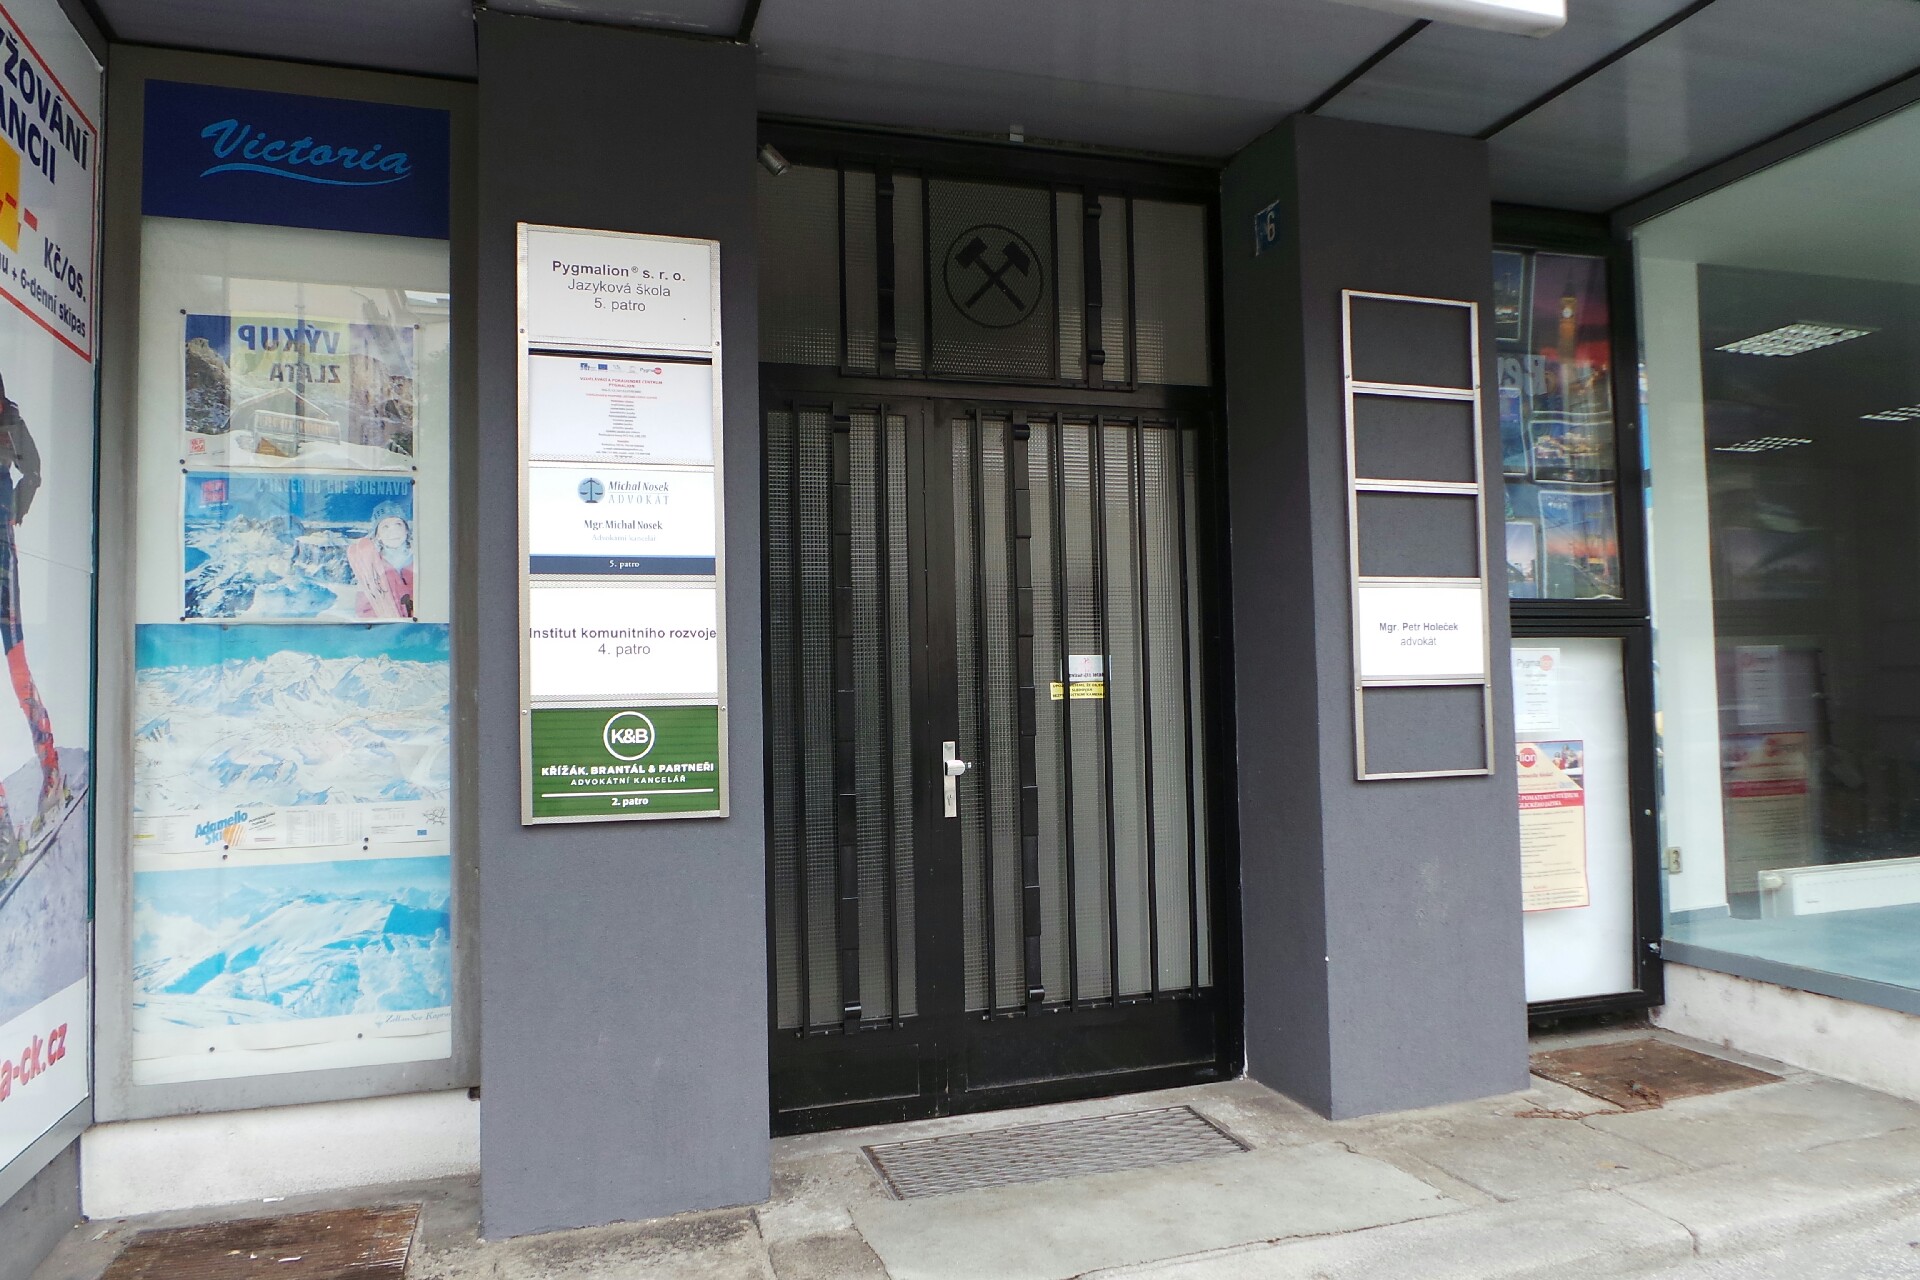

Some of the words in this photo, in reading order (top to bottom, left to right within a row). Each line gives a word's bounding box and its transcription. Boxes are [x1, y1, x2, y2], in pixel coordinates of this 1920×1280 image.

[0, 27, 89, 171] ŽOVÁNÍ
[200, 118, 413, 176] Victoria
[44, 236, 87, 303] Kč/os.
[567, 278, 632, 295] Jazyková
[636, 281, 671, 298] škola
[593, 297, 606, 310] 5.
[611, 299, 646, 314] patro
[59, 302, 86, 338] skipas
[354, 480, 409, 496] SOGNAVO
[608, 481, 641, 491] Michal
[643, 482, 669, 492] Nosek
[605, 520, 636, 530] Michal
[638, 520, 663, 530] Nosek
[610, 560, 617, 568] 5.
[619, 560, 640, 570] patro
[529, 628, 577, 639] Institut
[670, 628, 717, 641] rozvoje
[1379, 622, 1400, 634] Mgr.
[1402, 622, 1421, 632] Petr
[1423, 621, 1459, 632] Holeček
[1400, 636, 1437, 646] advokát
[598, 643, 611, 655] 4.
[616, 644, 650, 658] patro
[611, 728, 649, 744] K&B
[591, 763, 646, 775] BRANTÁL
[648, 764, 656, 773] &
[659, 762, 714, 773] PARTNEŘI
[570, 775, 630, 786] ADVOKÁTNÍ
[634, 774, 686, 784] KANCELÁŘ
[611, 797, 621, 806] 2.
[622, 796, 649, 808] patro
[195, 810, 248, 838] Adamello
